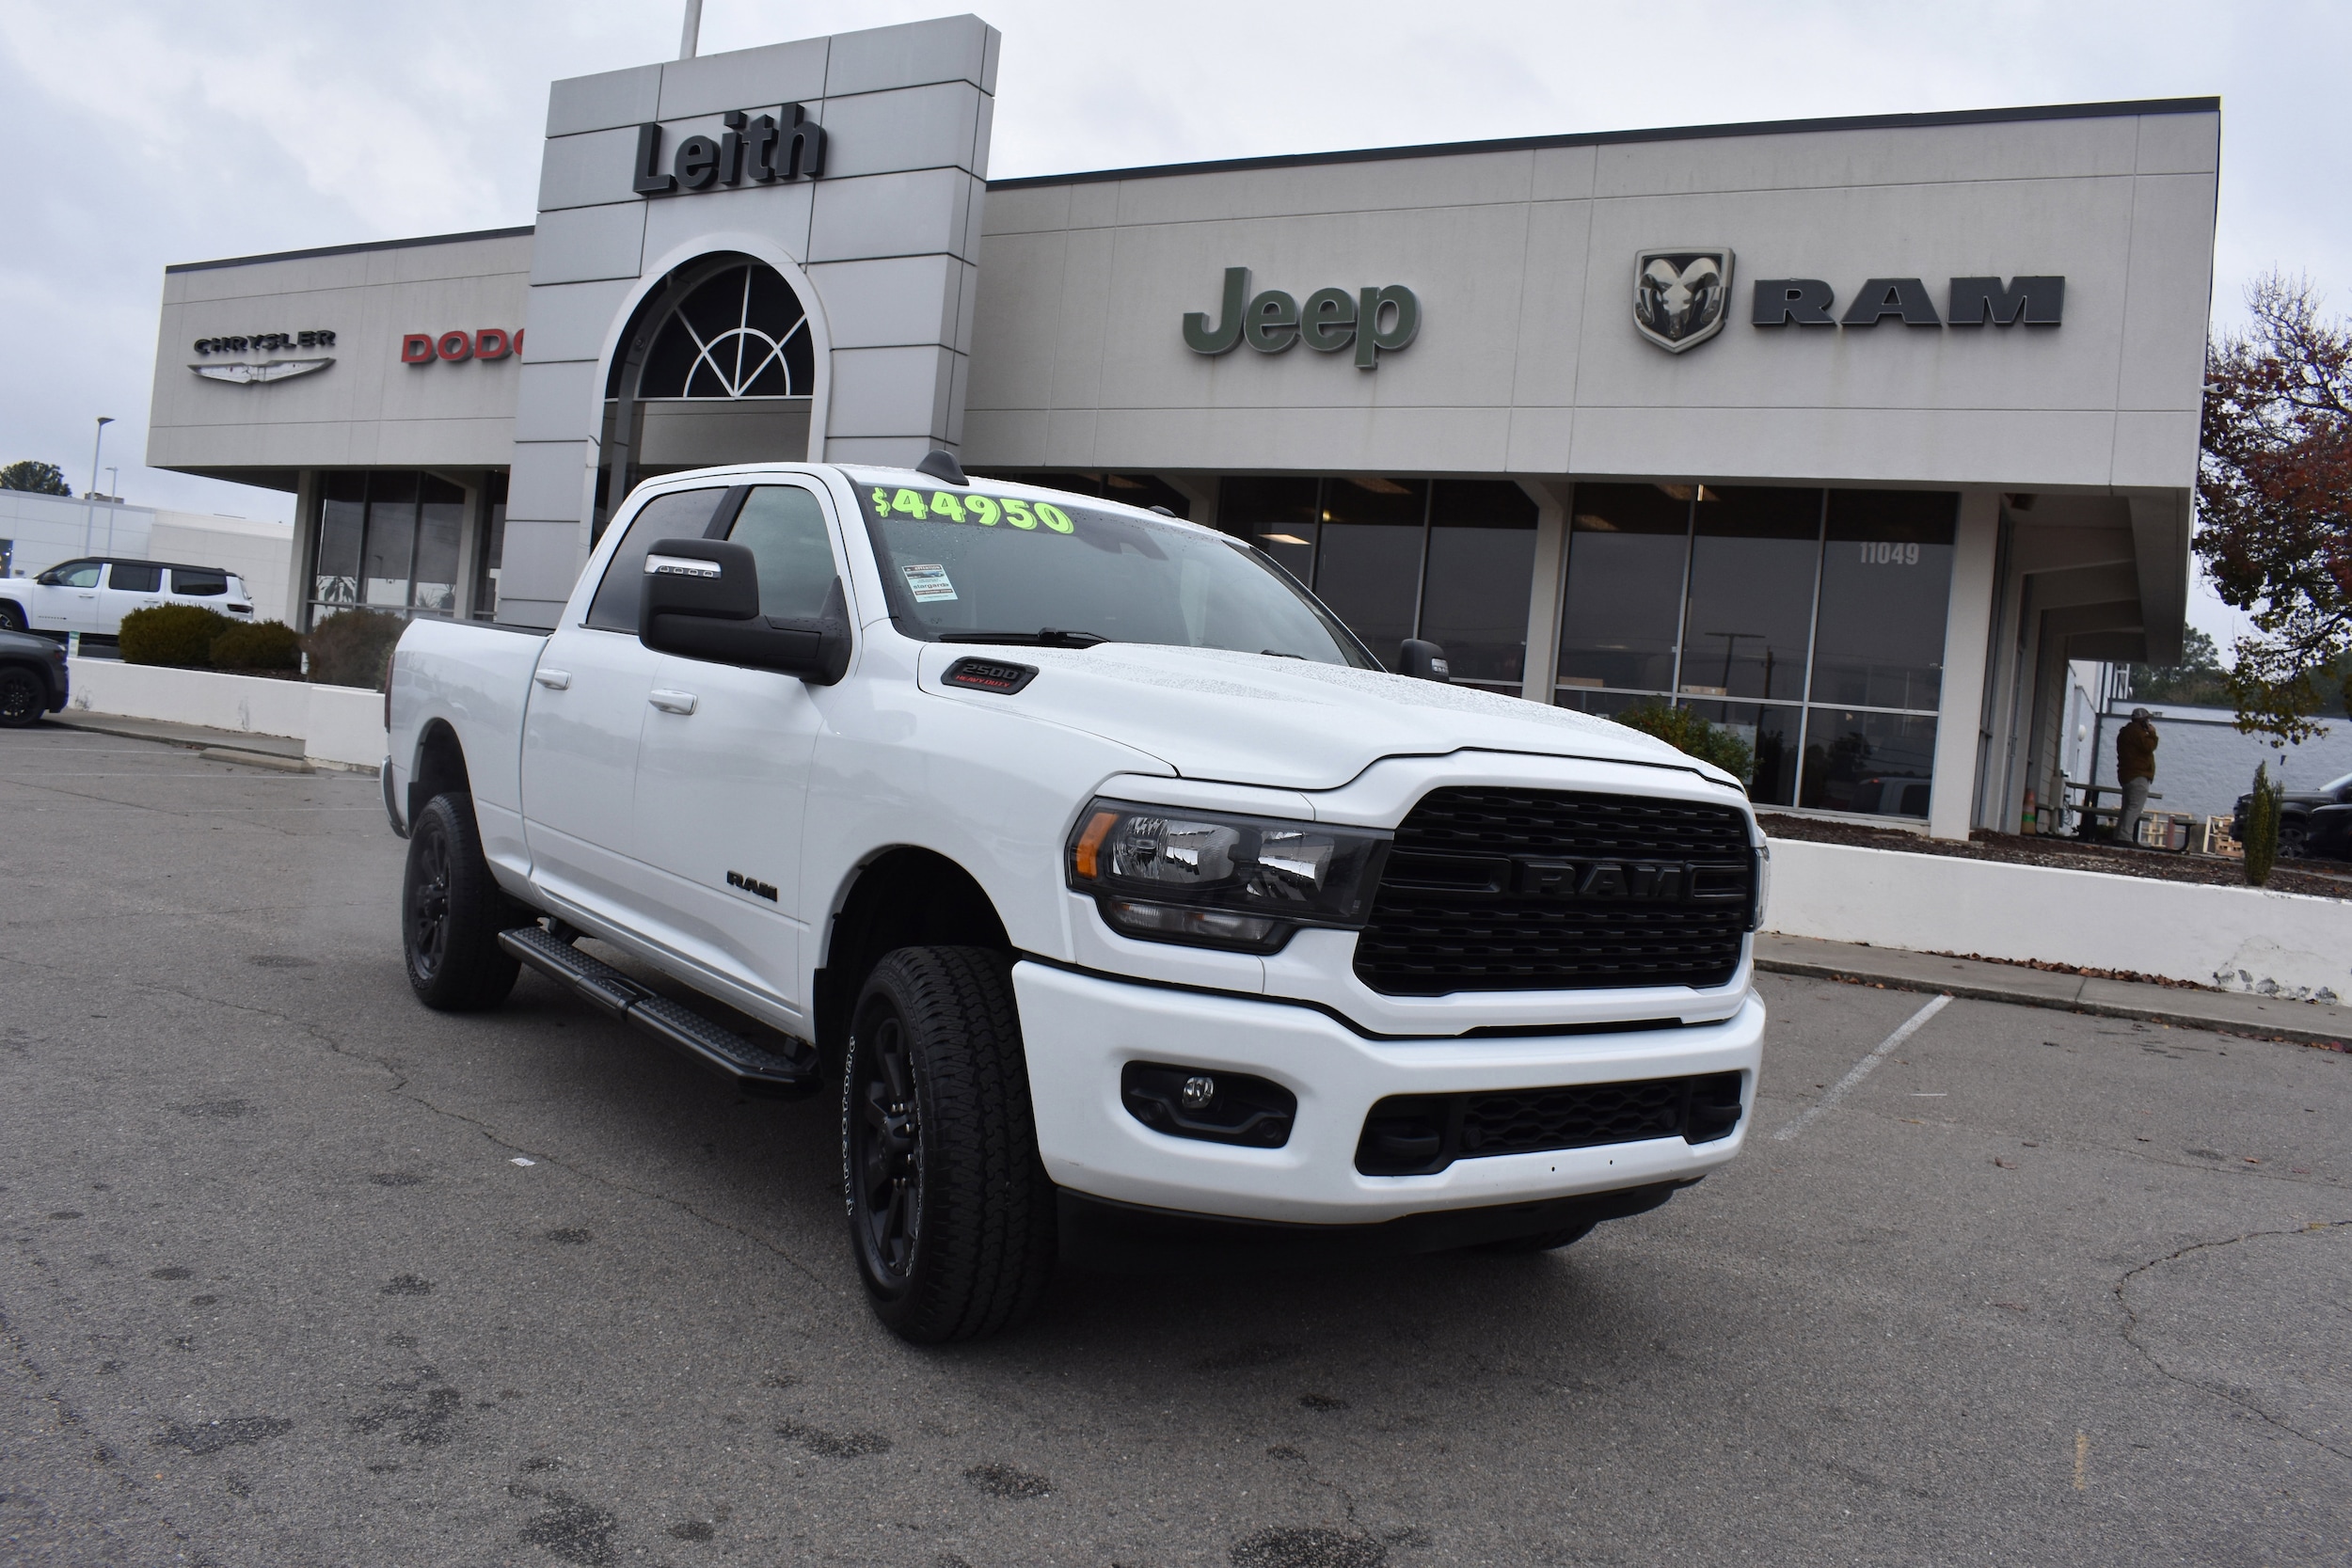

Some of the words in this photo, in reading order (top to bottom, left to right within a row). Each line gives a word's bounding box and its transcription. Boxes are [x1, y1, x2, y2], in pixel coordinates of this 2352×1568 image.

[633, 103, 827, 196] Leith
[1752, 276, 2065, 327] RAM
[1183, 267, 1422, 369] Jeep
[194, 330, 337, 355] CHRYSLER
[872, 487, 1074, 534] $44950
[1860, 542, 1919, 564] 11049
[955, 674, 985, 684] HEAVY
[984, 678, 1010, 688] DUTY
[962, 663, 1019, 680] 2500
[726, 870, 778, 902] RAM
[1522, 862, 1681, 895] RAM
